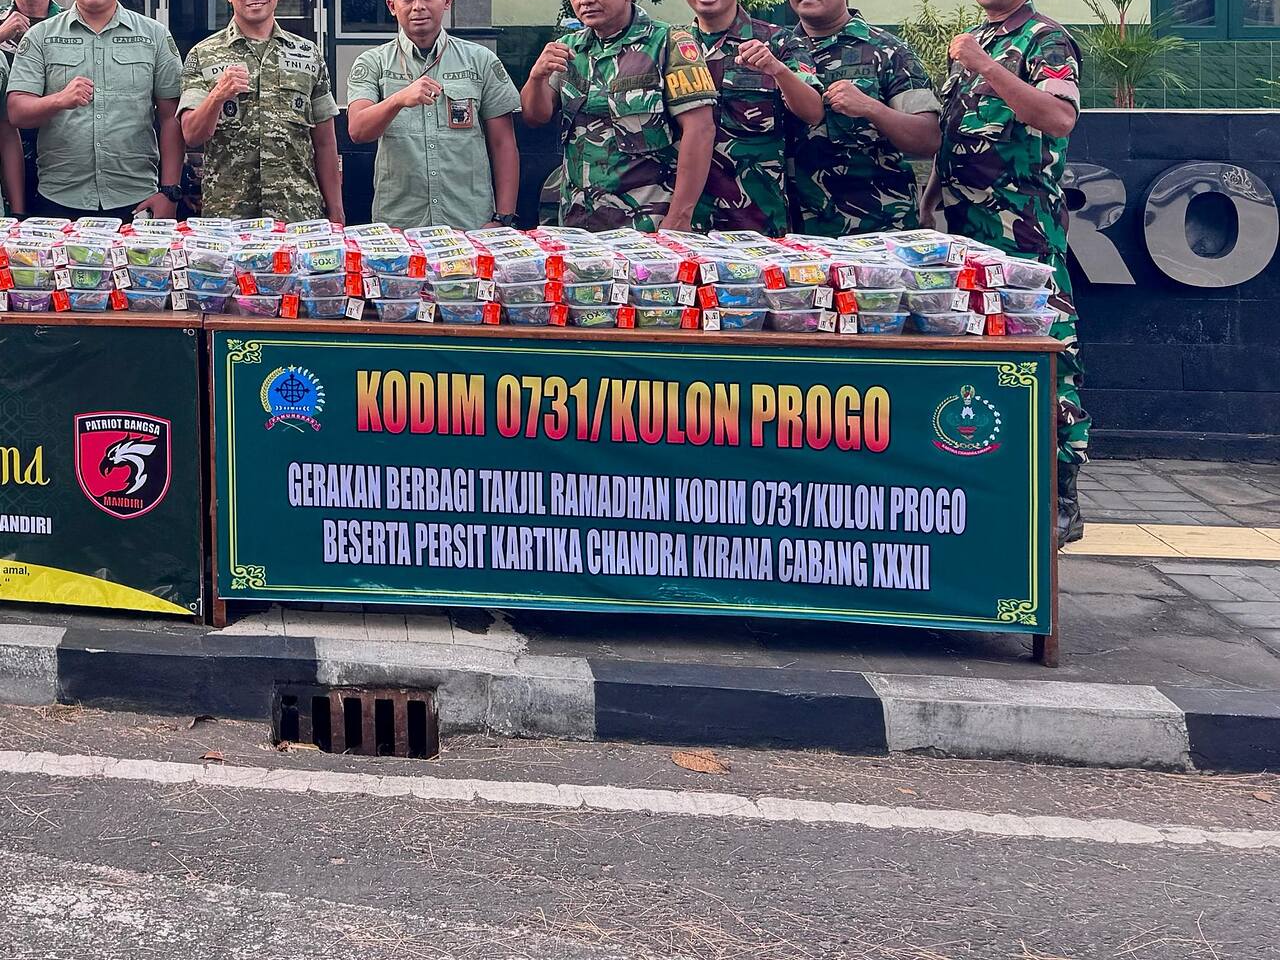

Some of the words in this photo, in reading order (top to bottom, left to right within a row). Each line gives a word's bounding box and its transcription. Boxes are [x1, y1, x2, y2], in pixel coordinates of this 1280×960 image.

[285, 60, 302, 69] TNI
[305, 63, 317, 73] AD
[854, 68, 871, 76] AD
[356, 369, 485, 437] KODIM
[496, 374, 740, 447] 0731/KULON
[751, 383, 891, 453] PROGO
[85, 419, 123, 431] PATRIOT
[125, 419, 161, 436] BANGSA
[103, 496, 144, 509] MANDIRI
[288, 462, 381, 509] GERAKAN
[386, 466, 474, 513] BERBAGI
[479, 469, 546, 515] TAKJIL
[550, 472, 670, 521] RAMADHAN
[675, 478, 746, 525] KODIM
[751, 480, 885, 530] 0731/KULON
[890, 486, 967, 535] PROGO
[323, 519, 412, 566] BESERTA
[415, 522, 487, 569] PERSIT
[491, 525, 583, 574] KARTIKA
[587, 528, 688, 577] CHANDRA
[692, 535, 773, 581] KIRANA
[778, 538, 868, 587] CABANG
[872, 542, 930, 590] XXXII
[3, 565, 30, 577] amal,
